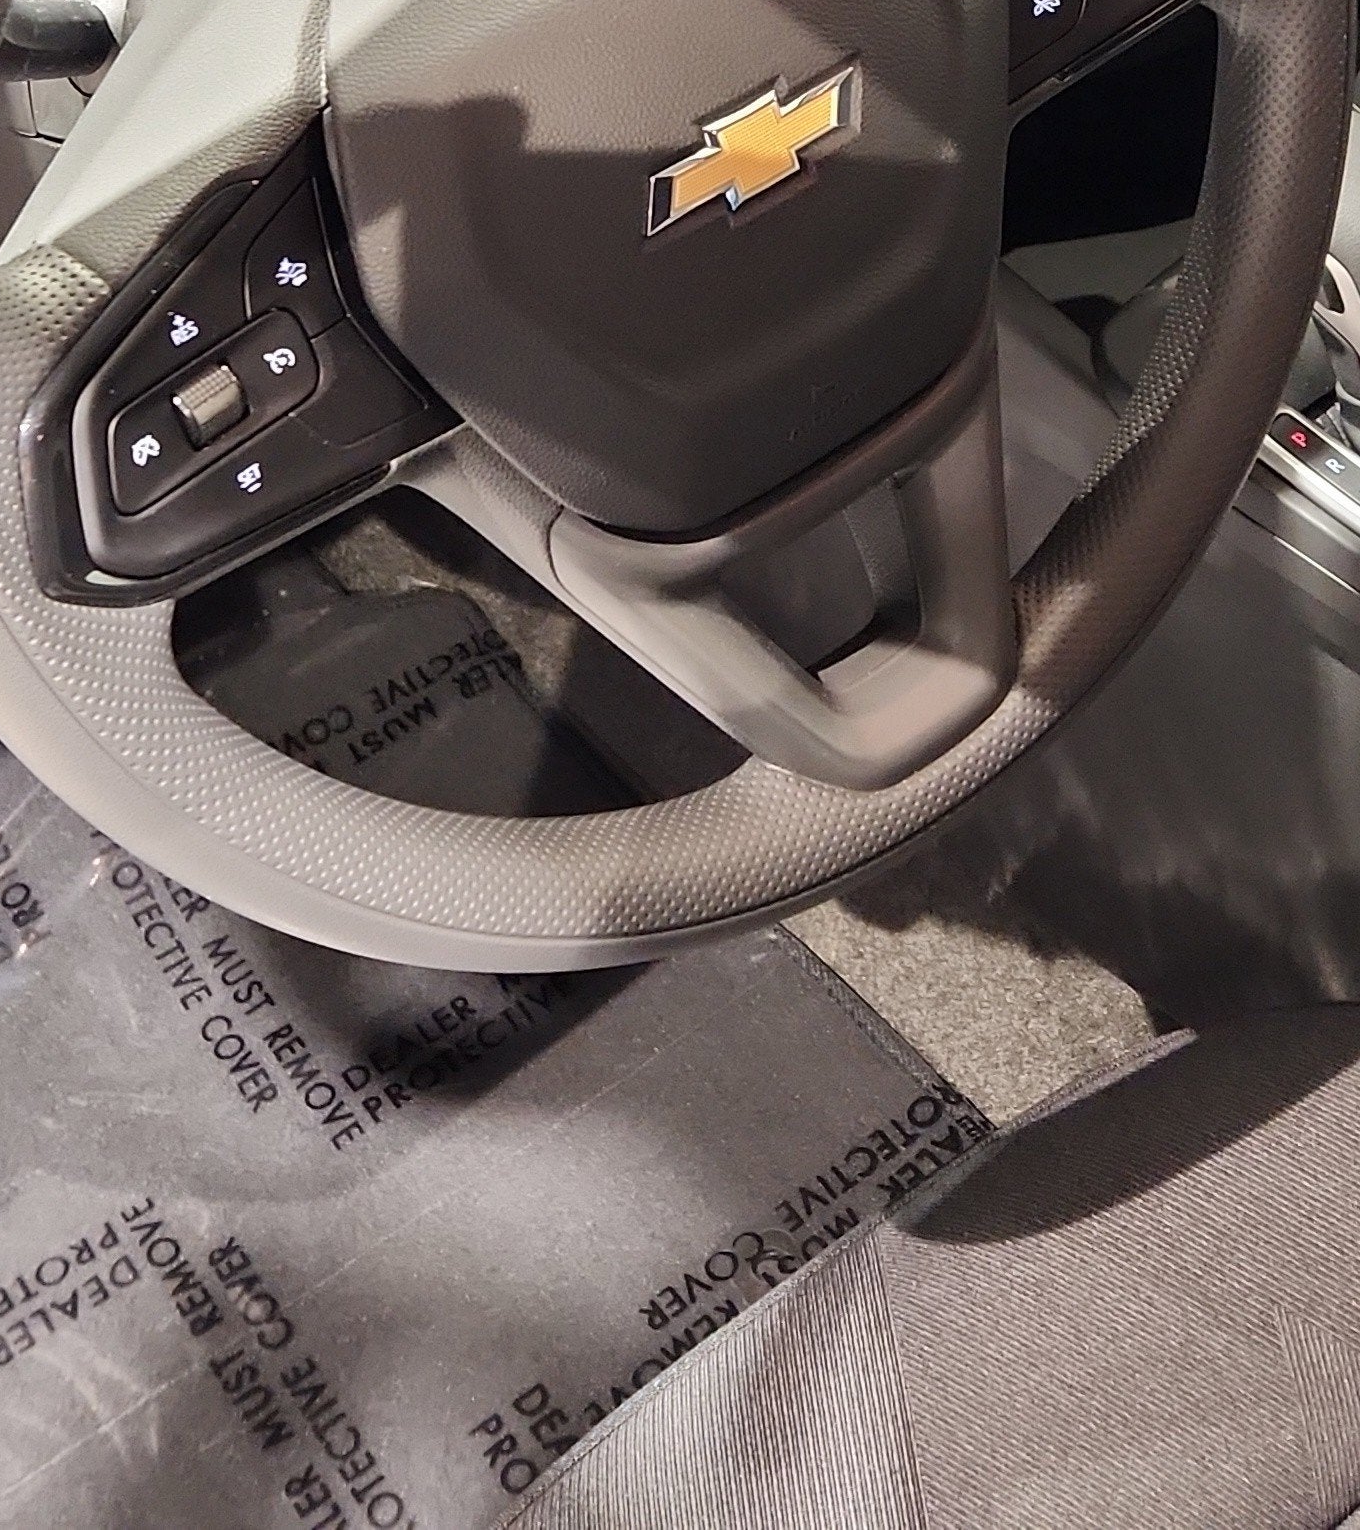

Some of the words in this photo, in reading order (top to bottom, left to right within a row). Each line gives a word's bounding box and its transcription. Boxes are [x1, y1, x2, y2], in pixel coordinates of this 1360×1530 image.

[1290, 430, 1308, 448] P
[1324, 457, 1346, 475] R
[200, 1014, 279, 1114] COVER
[202, 934, 276, 1016] MUST
[262, 1023, 366, 1151] REMOVE
[341, 995, 478, 1093] DEALER
[119, 1196, 225, 1338] REMOVE
[207, 1348, 296, 1453] MUST
[208, 1235, 296, 1351] COVER
[638, 1231, 765, 1330] COVER
